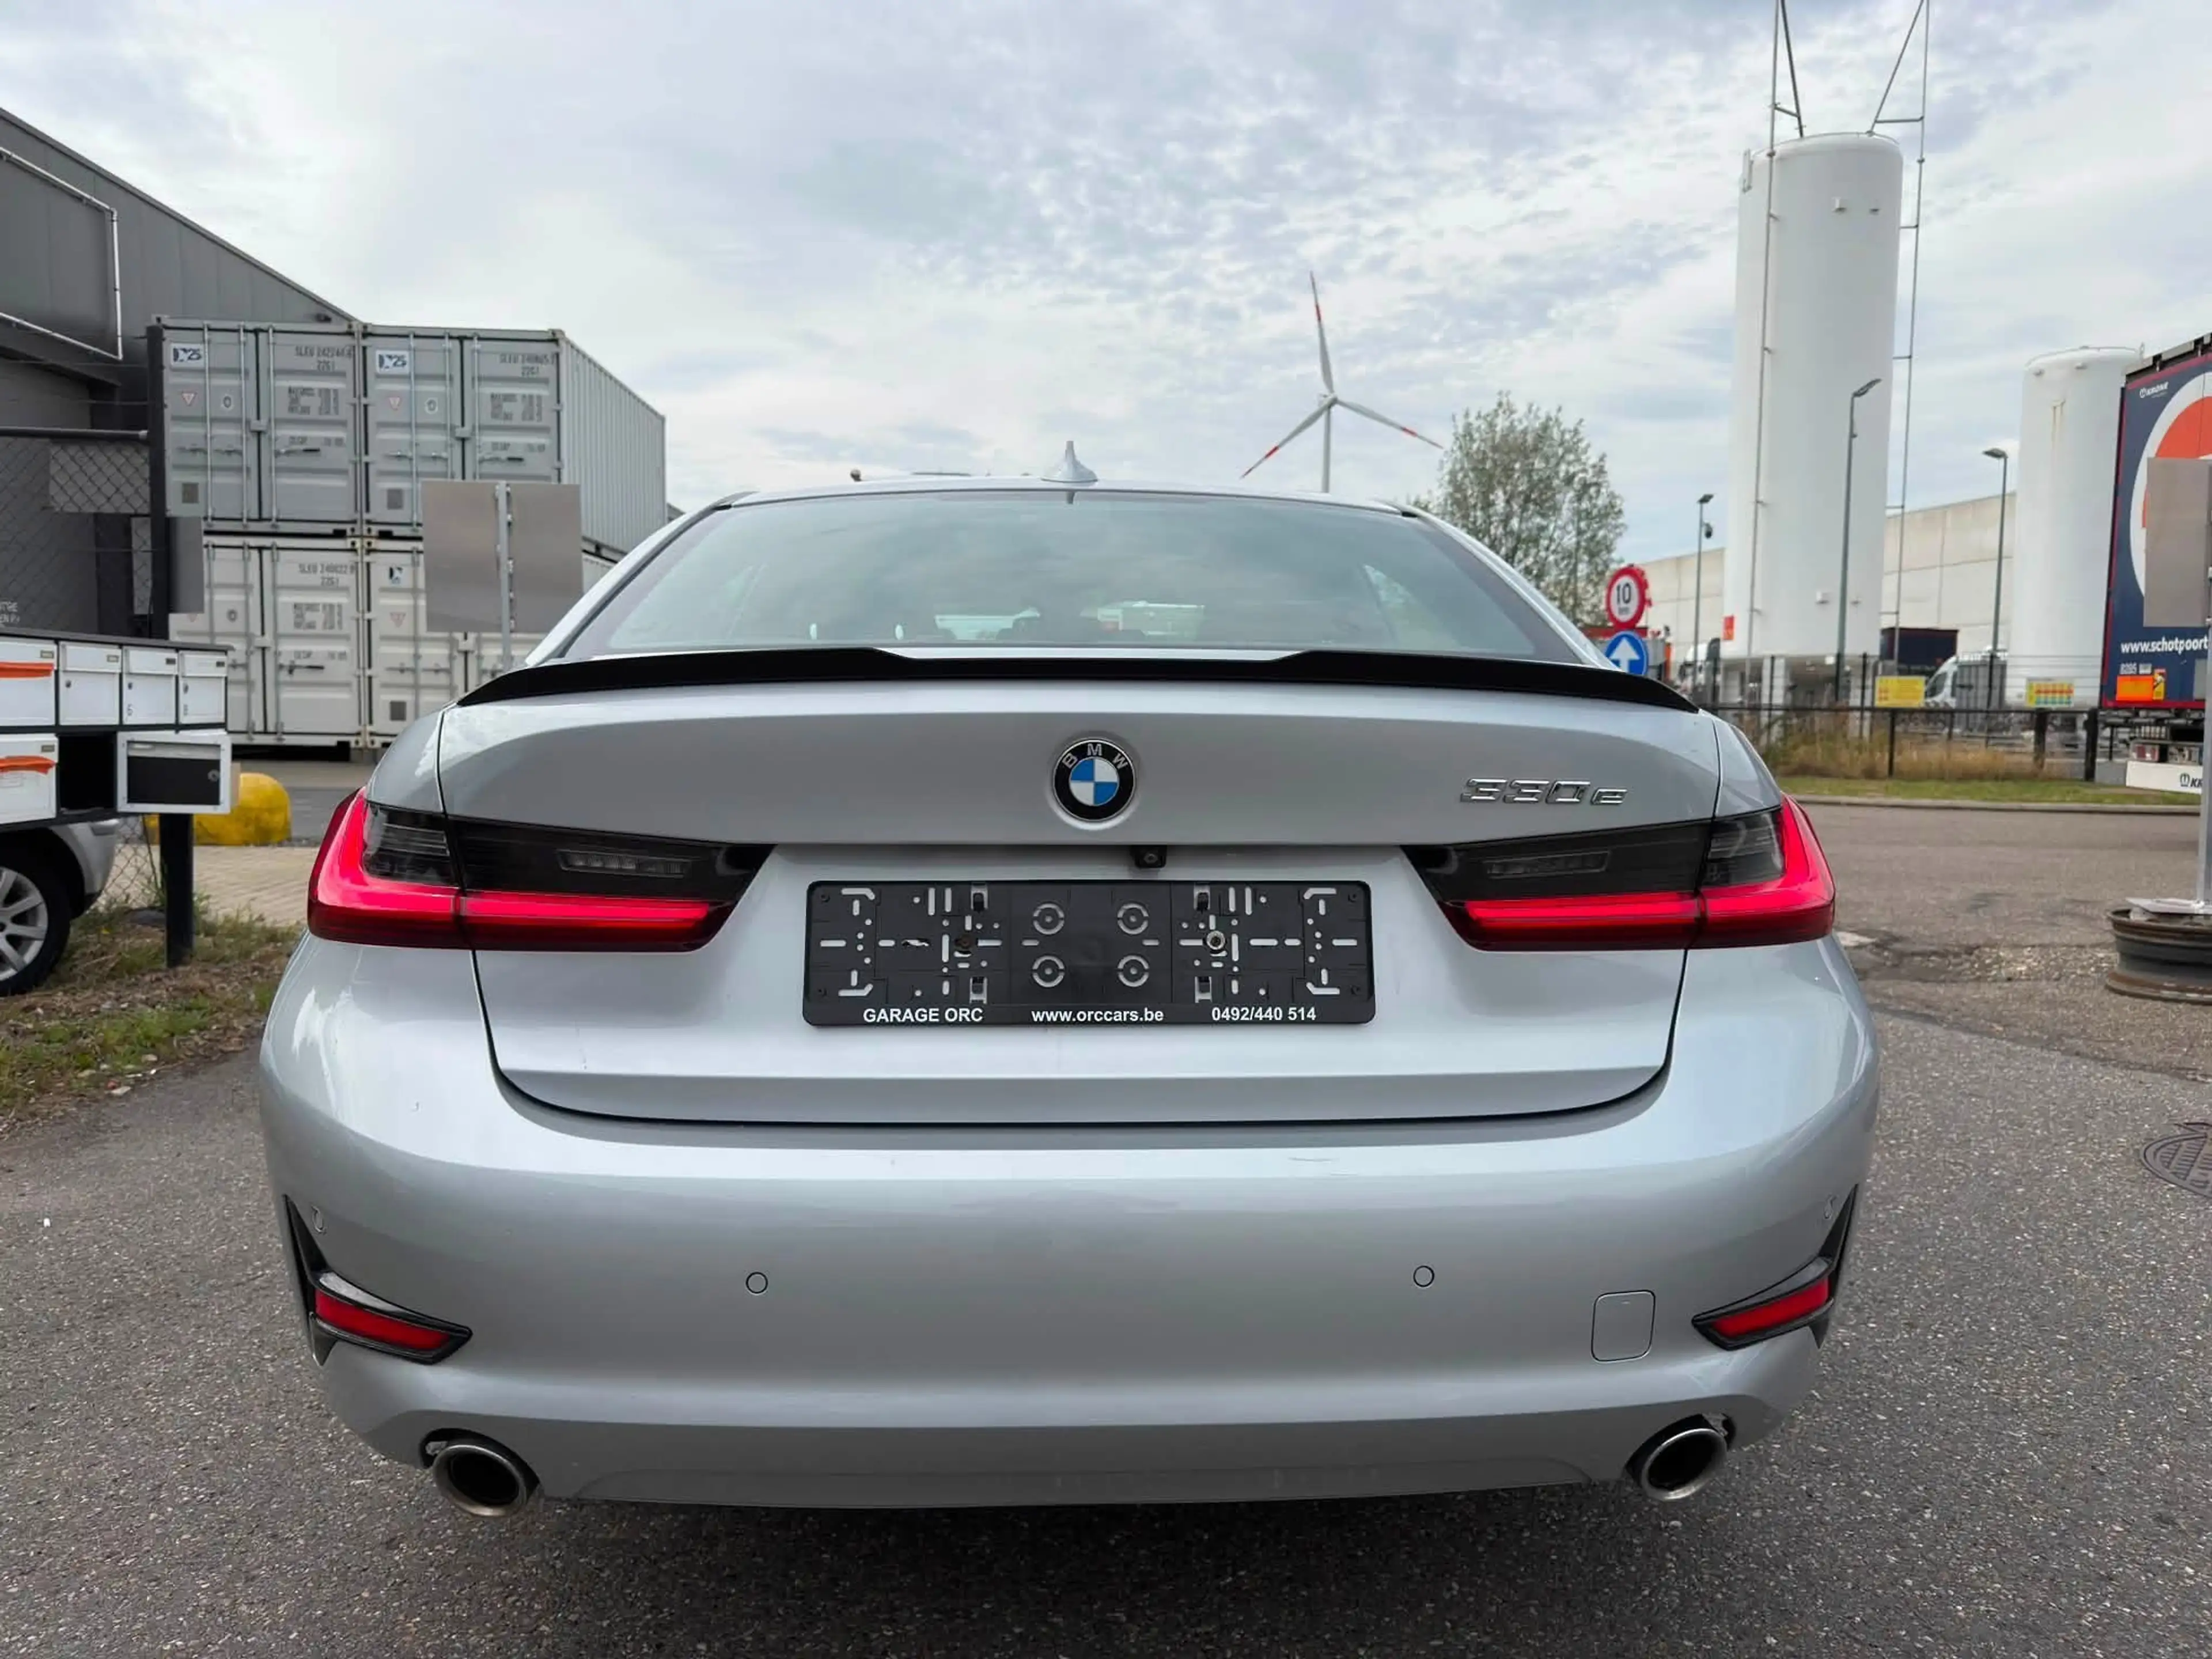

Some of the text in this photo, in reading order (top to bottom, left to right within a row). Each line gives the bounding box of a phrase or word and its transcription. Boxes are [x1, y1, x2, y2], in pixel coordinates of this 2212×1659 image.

[1616, 582, 1631, 605] 10
[1062, 743, 1129, 770] BMW
[1459, 778, 1628, 805] 330e
[863, 1007, 983, 1022] GARAGE ORC
[1031, 1007, 1164, 1022] www.orccars.be
[1211, 1006, 1317, 1021] 0492/440 514
